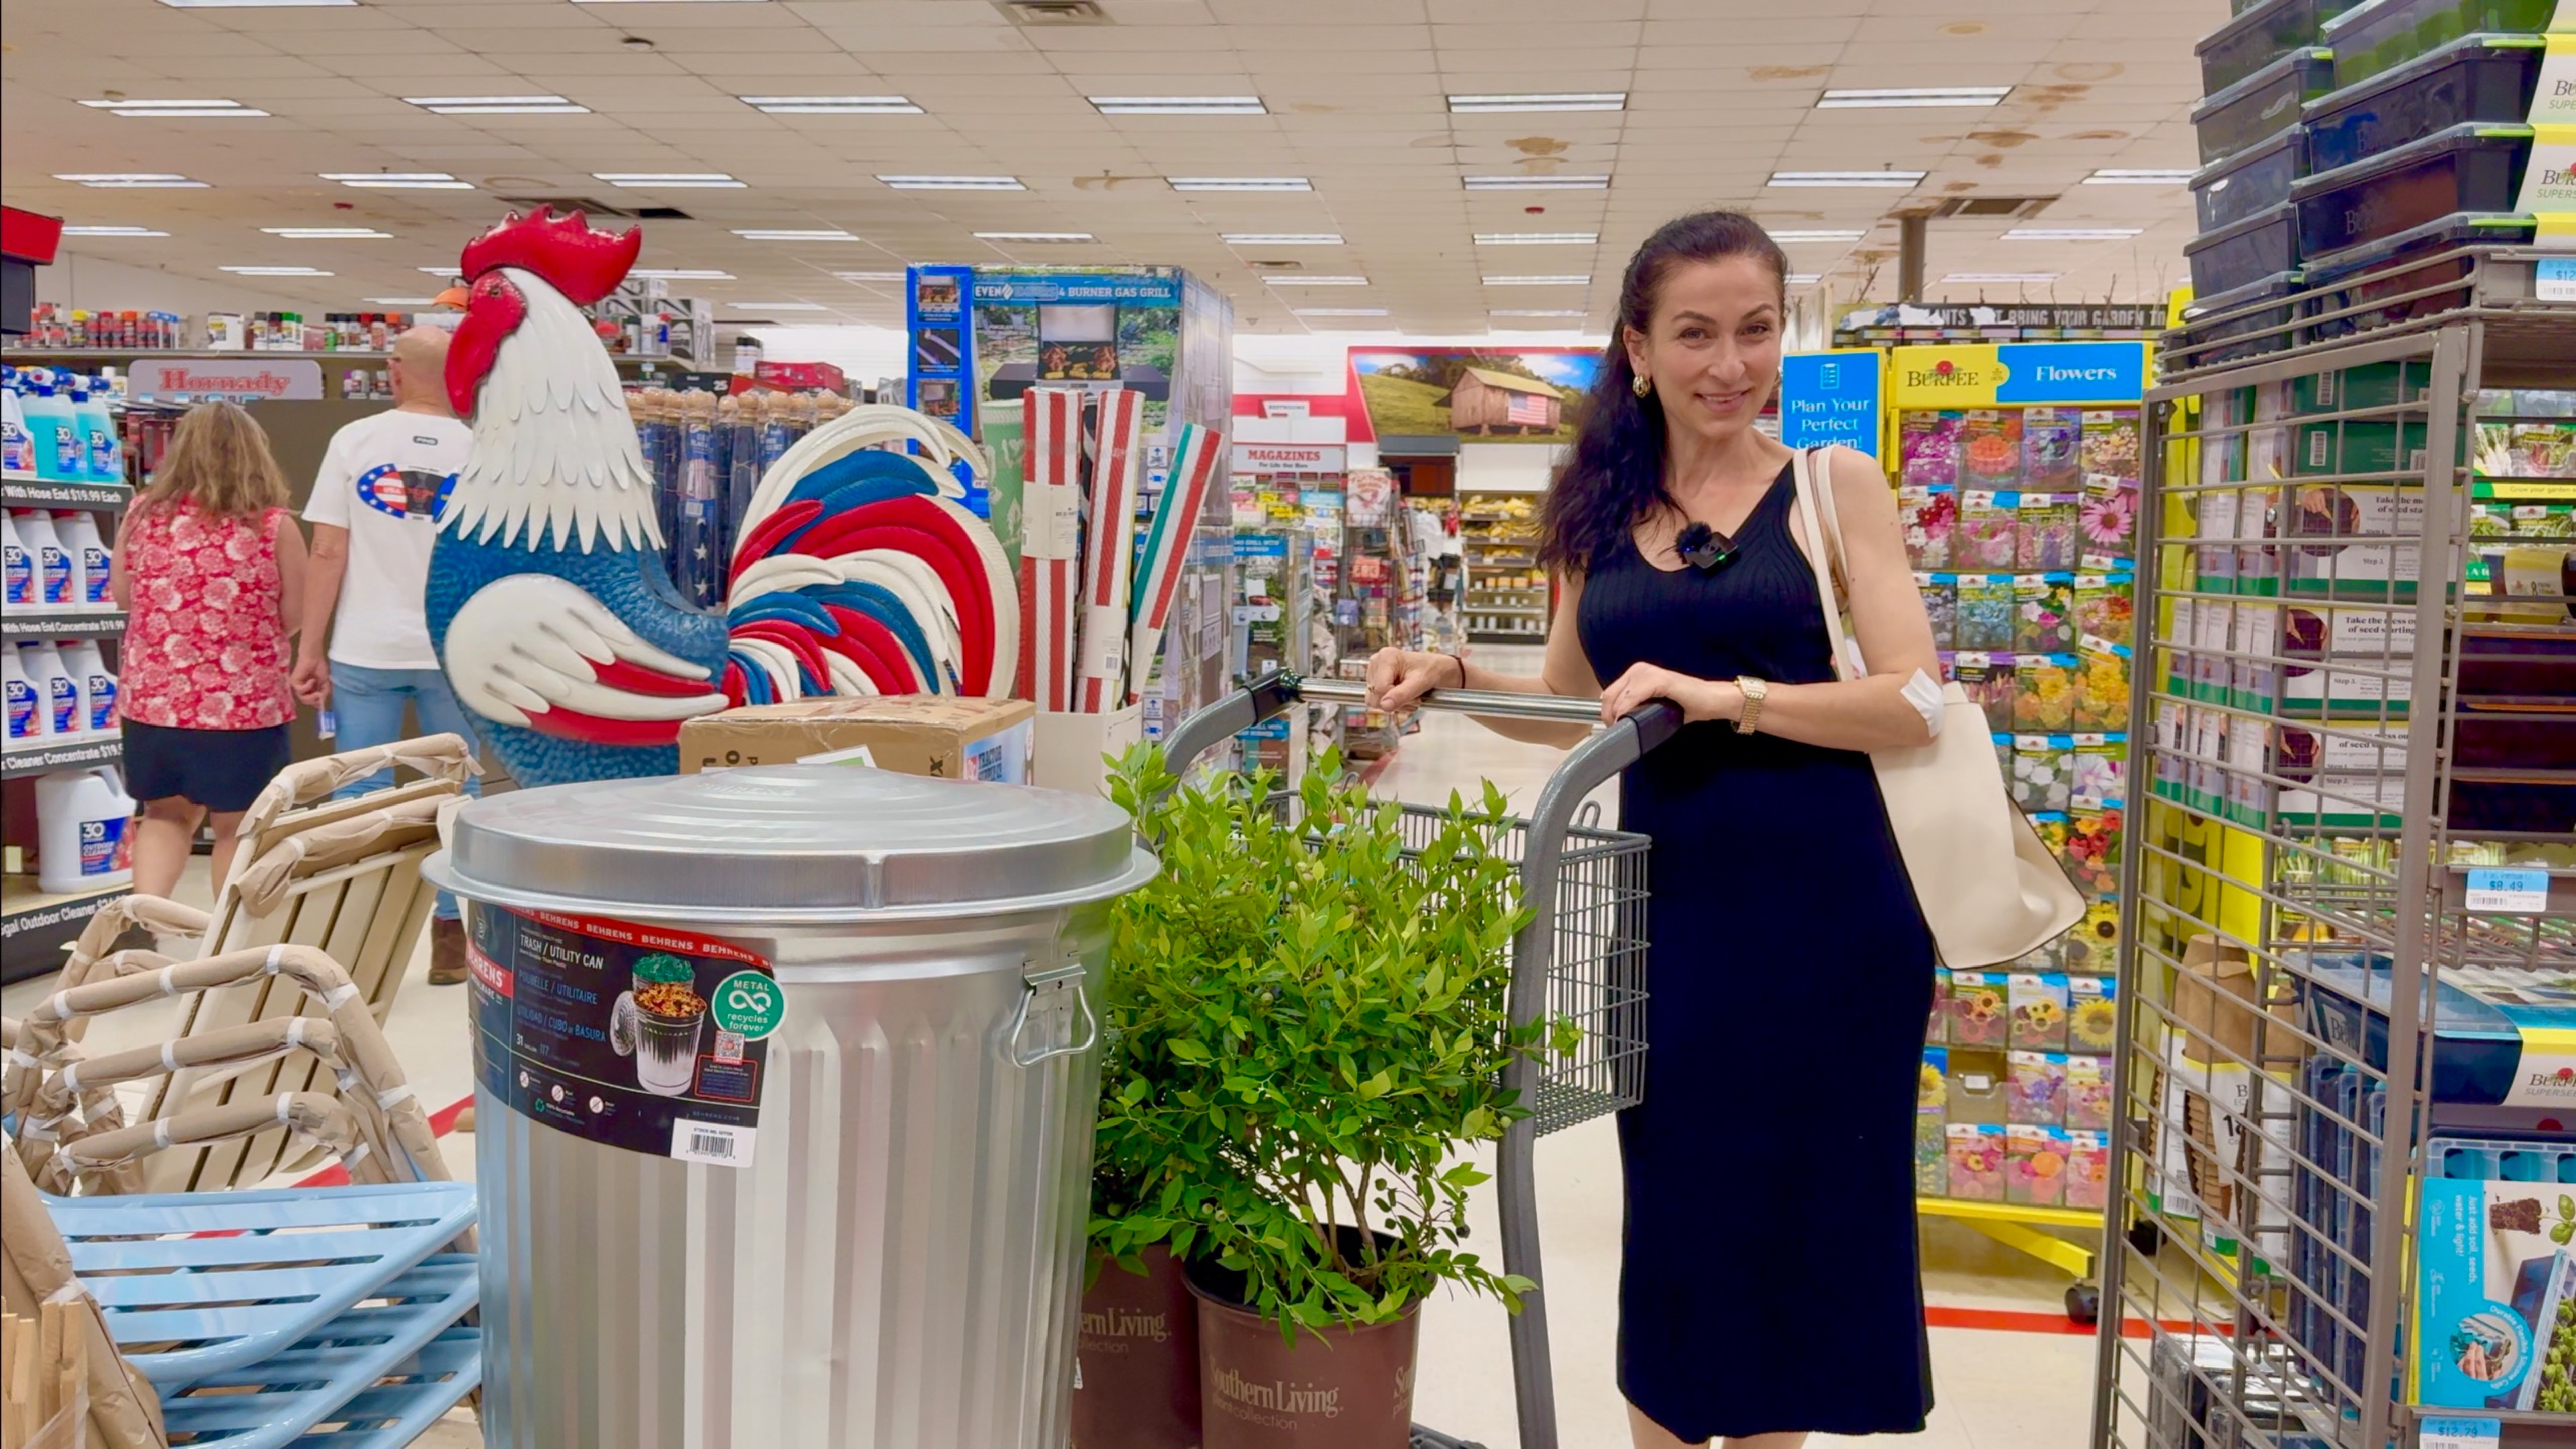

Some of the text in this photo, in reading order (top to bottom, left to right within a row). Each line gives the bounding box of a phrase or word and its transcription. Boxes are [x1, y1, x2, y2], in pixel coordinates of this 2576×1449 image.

[2537, 189, 2576, 199] SUPERS
[975, 286, 1001, 297] EVEN
[1059, 287, 1065, 296] 4
[1068, 287, 1112, 297] BURNER
[1115, 287, 1137, 297] GAS
[1140, 287, 1171, 298] GRILL
[2053, 310, 2087, 326] YOUR
[2092, 310, 2145, 326] GARDEN
[159, 368, 290, 396] Hornady
[1907, 370, 1979, 387] BURPEE
[2035, 365, 2117, 382] Flowers
[713, 380, 728, 391] 25
[1791, 397, 1871, 414] Plan Your
[1801, 416, 1859, 431] Perfect
[56, 427, 71, 440] 30
[90, 431, 105, 445] 30
[1796, 435, 1862, 451] Garden!
[1248, 450, 1321, 461] MAGAZINES
[4, 485, 26, 499] With
[27, 487, 52, 500] Hose
[52, 488, 70, 501] End
[70, 488, 101, 502] $19.99
[5, 548, 22, 562] 30
[43, 549, 59, 563] 30
[85, 549, 102, 564] 30
[2348, 625, 2359, 633] of
[7, 683, 25, 696] 30
[52, 679, 68, 693] 30
[90, 677, 106, 690] 30
[6, 754, 44, 770] Cleaner
[44, 748, 100, 765] Concentrate
[83, 822, 105, 838] 30
[20, 913, 60, 931] Outdoor
[61, 903, 96, 921] Cleaner
[540, 912, 755, 962] BEHRENS BEHRENS BEHRENS BEHRENS
[520, 934, 542, 953] TRASH
[549, 944, 581, 964] UTILITY
[582, 954, 604, 970] CAN
[733, 980, 769, 991] METAL
[556, 983, 598, 1005] UTILITAIRE
[727, 1013, 768, 1025] recycles
[547, 1014, 568, 1032] CUBO
[574, 1024, 606, 1042] BASURA
[728, 1021, 764, 1032] forever
[516, 1033, 524, 1046] 31
[2529, 1073, 2576, 1087] BURP
[2524, 1087, 2576, 1097] SUPERSE
[2454, 1194, 2463, 1222] water
[2454, 1223, 2465, 1231] &
[2468, 1217, 2478, 1234] add
[2490, 1304, 2517, 1326] Durable
[1209, 1355, 1275, 1409] Southern
